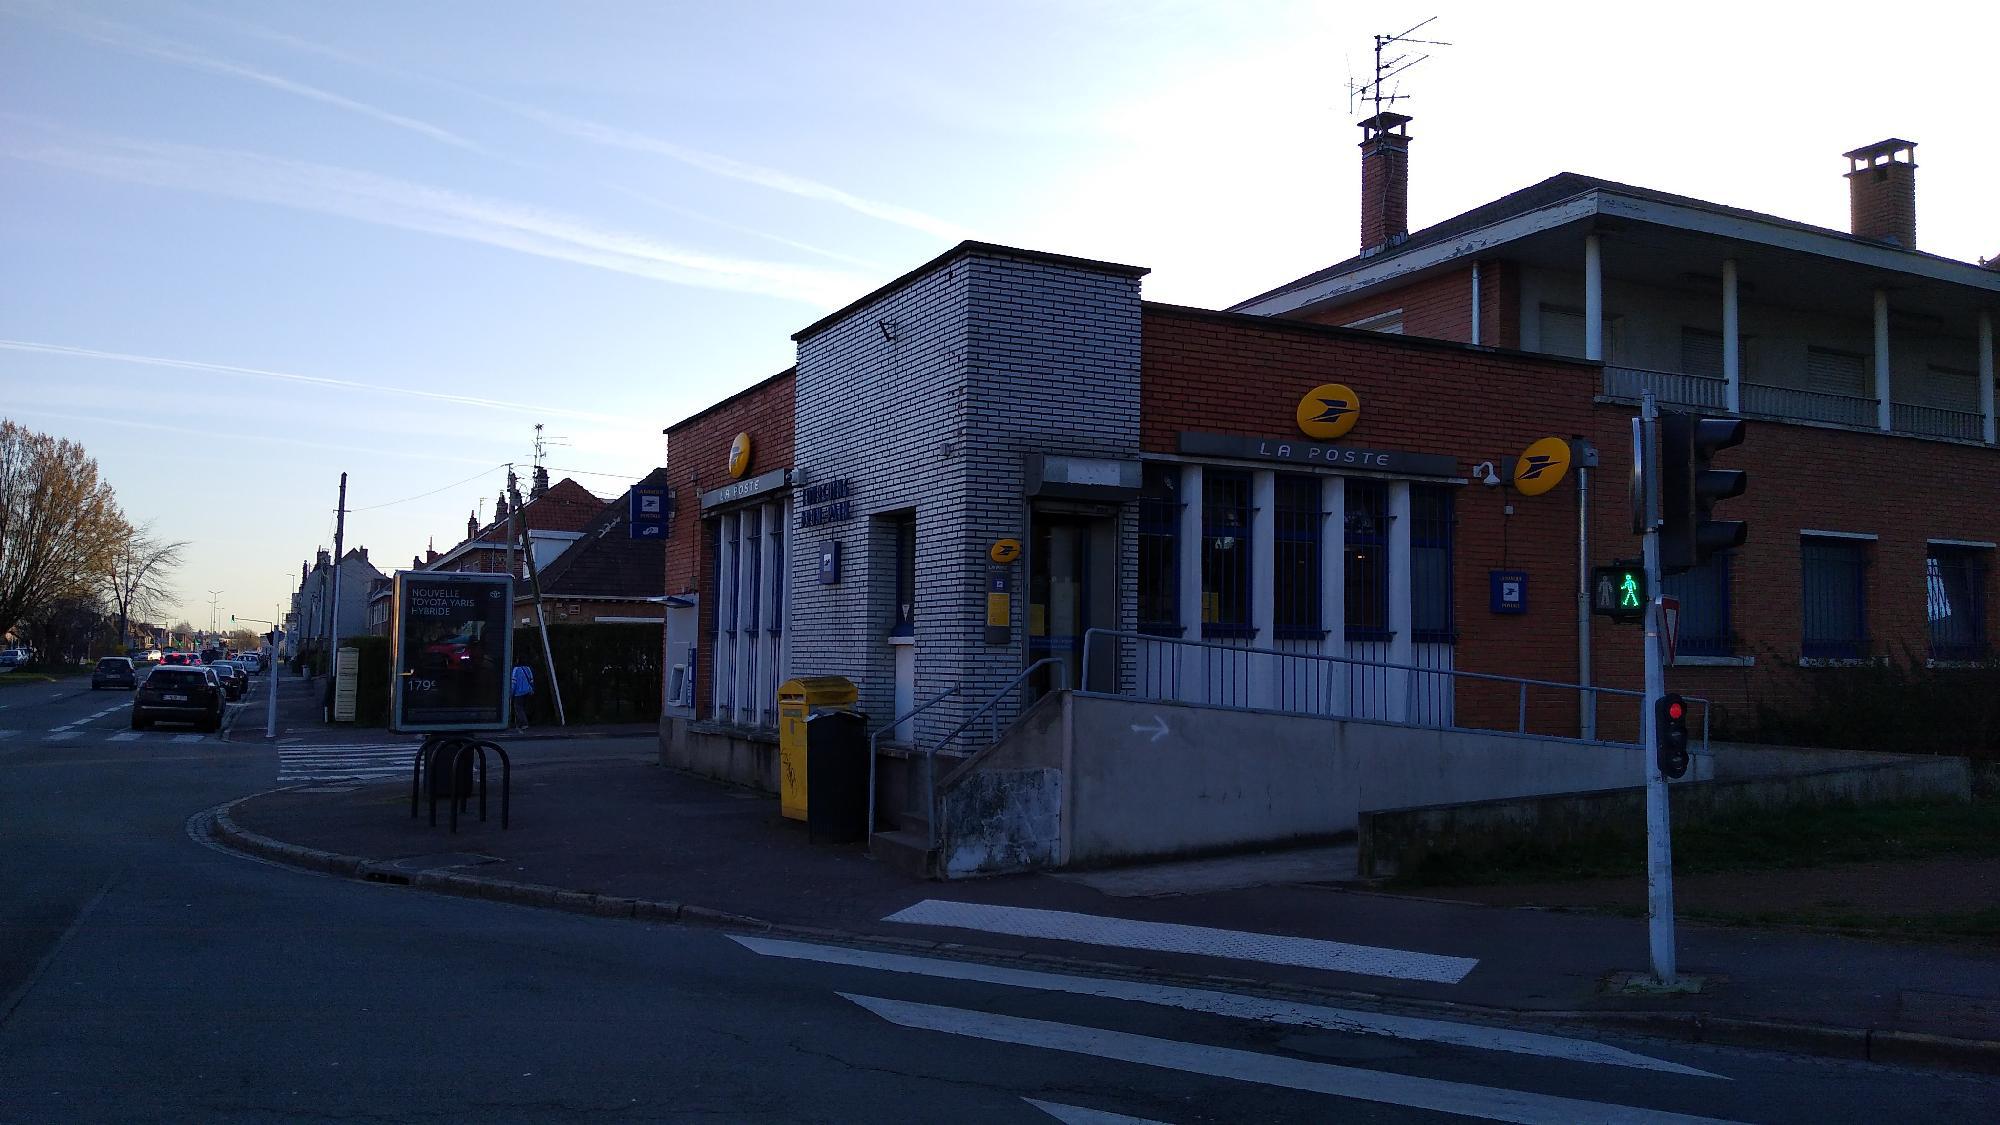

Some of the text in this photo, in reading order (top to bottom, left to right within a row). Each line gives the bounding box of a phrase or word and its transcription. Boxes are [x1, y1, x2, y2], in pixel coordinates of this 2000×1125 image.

[1259, 442, 1390, 466] LA POSTE
[719, 479, 760, 500] LA POSTE
[412, 588, 460, 598] NOUVELLE
[412, 598, 475, 607] TOYOTA YARIS
[411, 607, 450, 616] HYBRIDE
